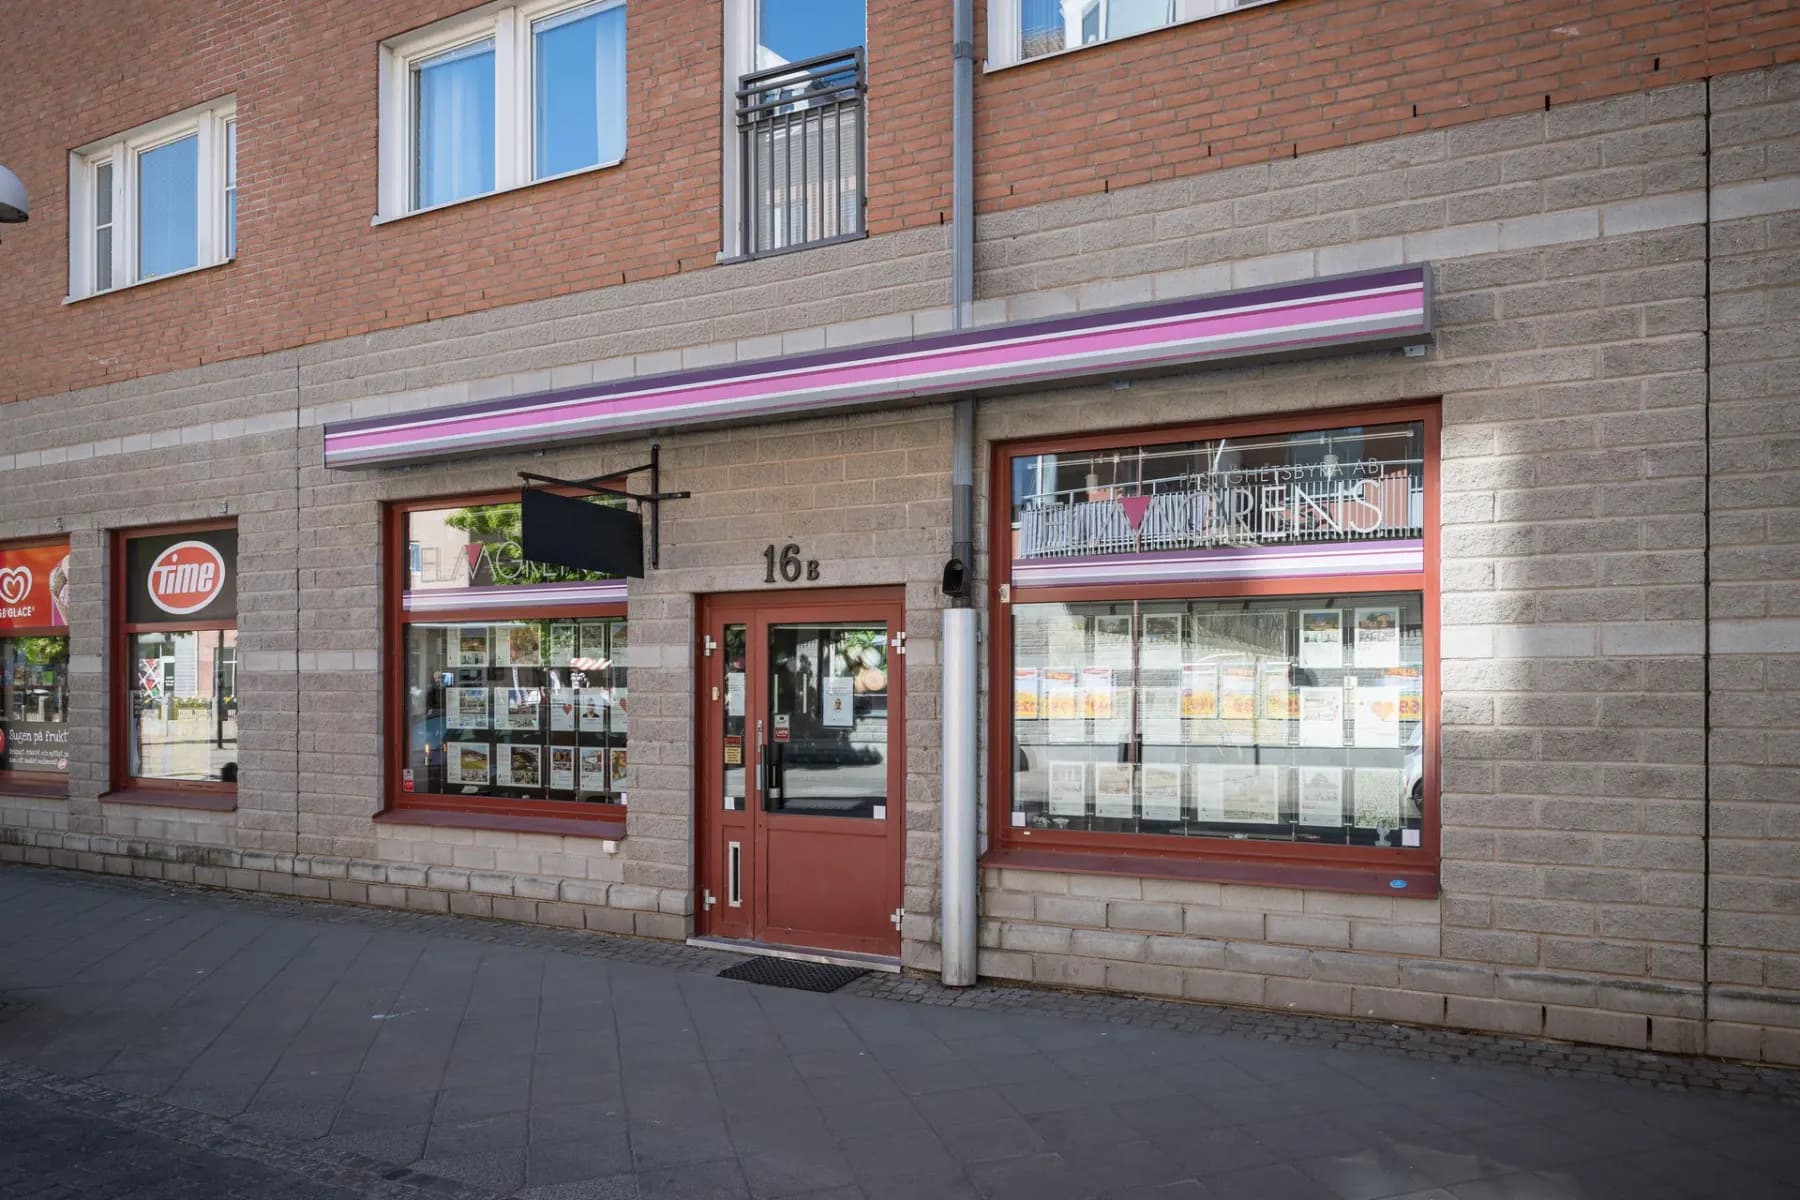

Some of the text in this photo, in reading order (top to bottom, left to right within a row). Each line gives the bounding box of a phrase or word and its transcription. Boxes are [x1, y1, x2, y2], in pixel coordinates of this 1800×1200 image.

[1353, 457, 1380, 475] AB
[763, 543, 820, 583] 16 B
[7, 606, 32, 618] GLACE
[9, 729, 32, 744] Sugen
[34, 731, 43, 745] på
